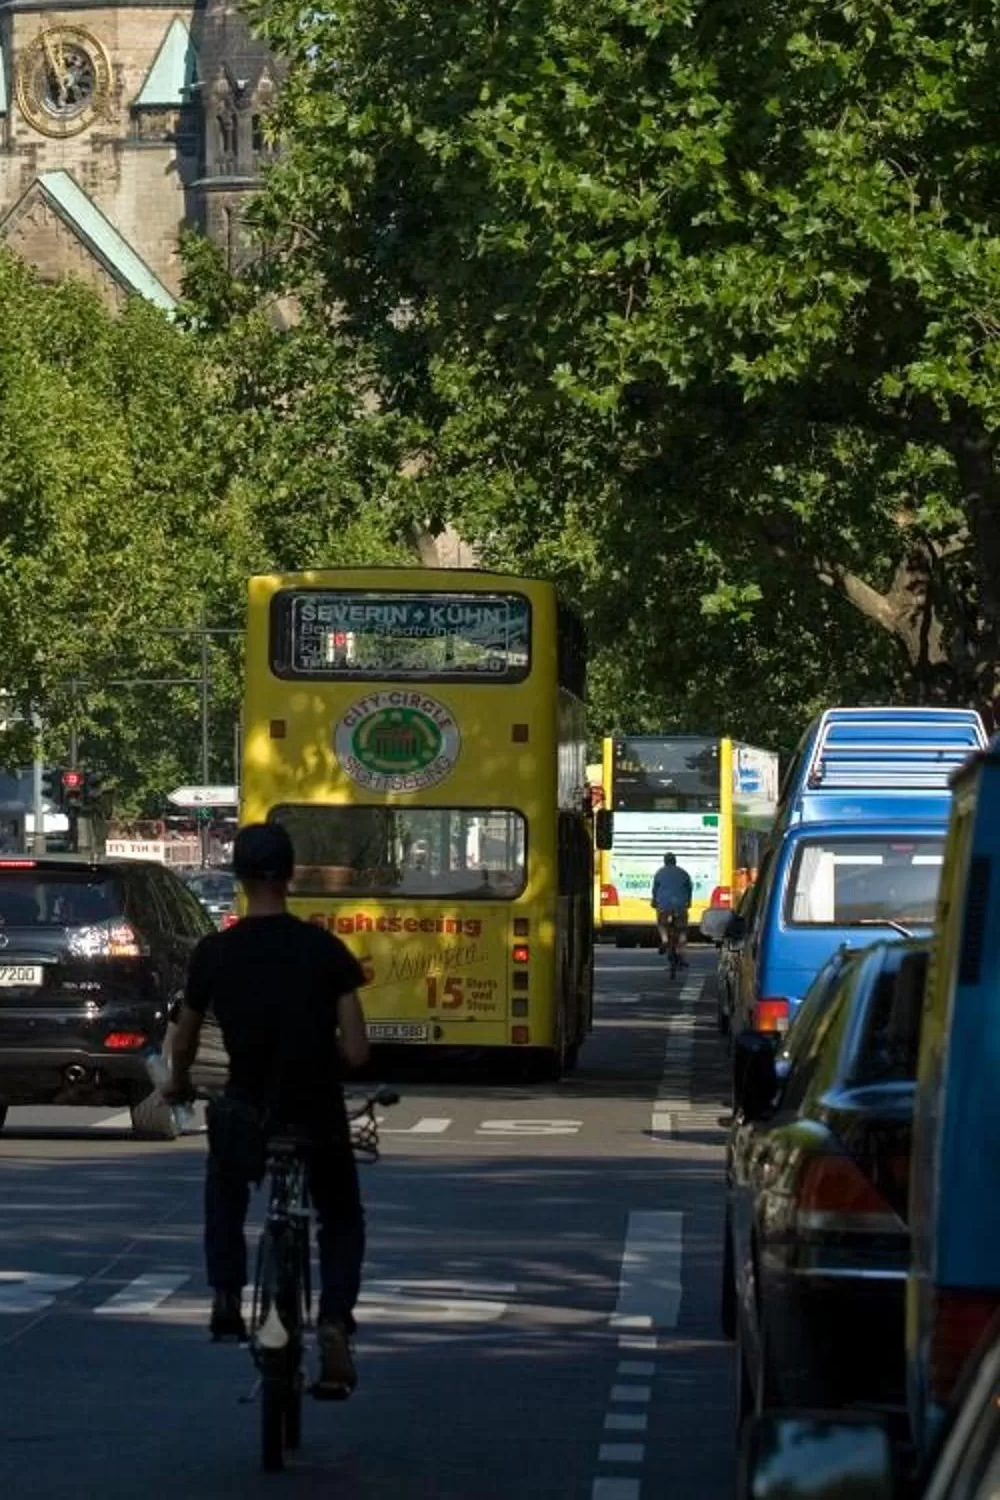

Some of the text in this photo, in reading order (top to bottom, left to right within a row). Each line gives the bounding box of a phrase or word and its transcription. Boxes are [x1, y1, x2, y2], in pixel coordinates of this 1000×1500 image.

[301, 604, 407, 622] SEVERIN
[430, 603, 501, 623] KÜHN
[426, 976, 464, 1009] 15
